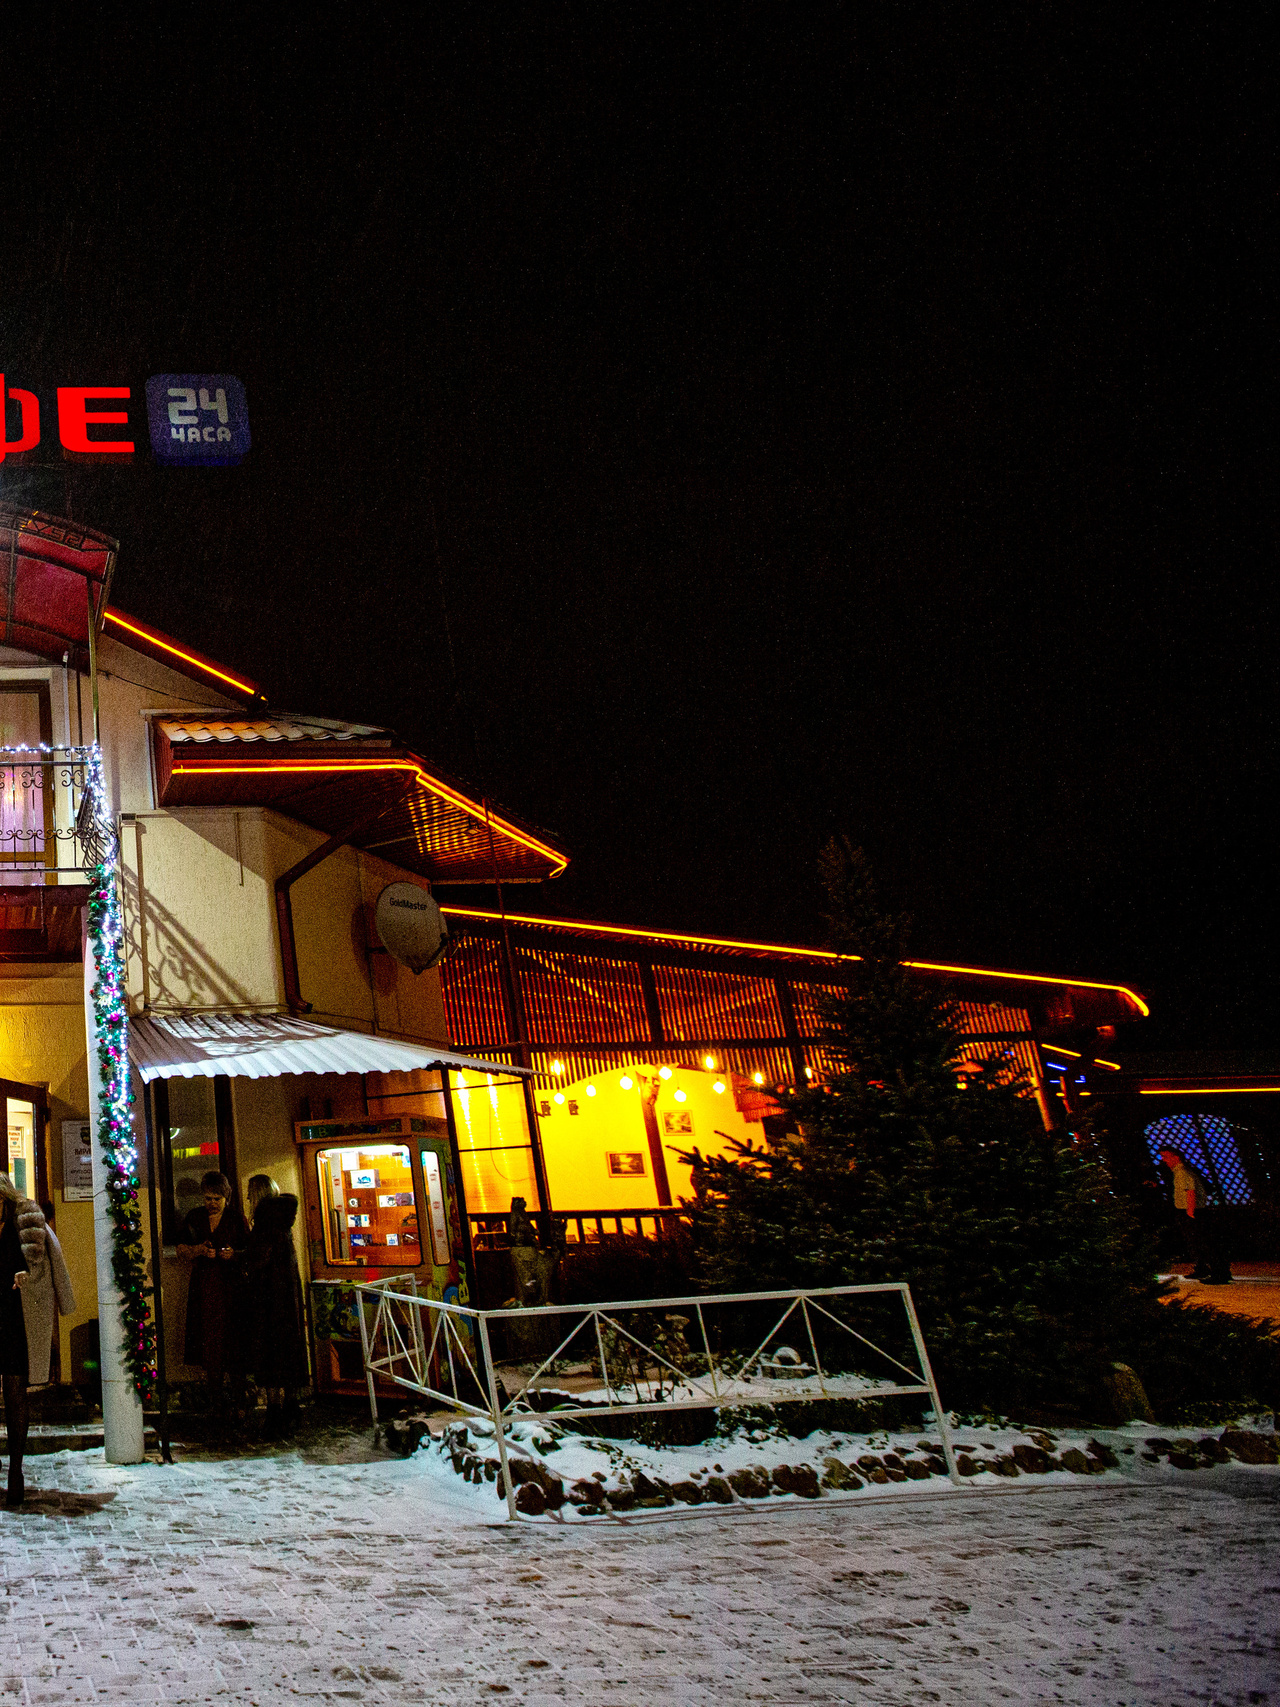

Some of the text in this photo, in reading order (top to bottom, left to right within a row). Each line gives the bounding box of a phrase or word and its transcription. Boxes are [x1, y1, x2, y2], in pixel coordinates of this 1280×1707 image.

[167, 388, 229, 424] 24
[170, 427, 231, 442] ЧАСА
[389, 897, 428, 910] GoldMaster
